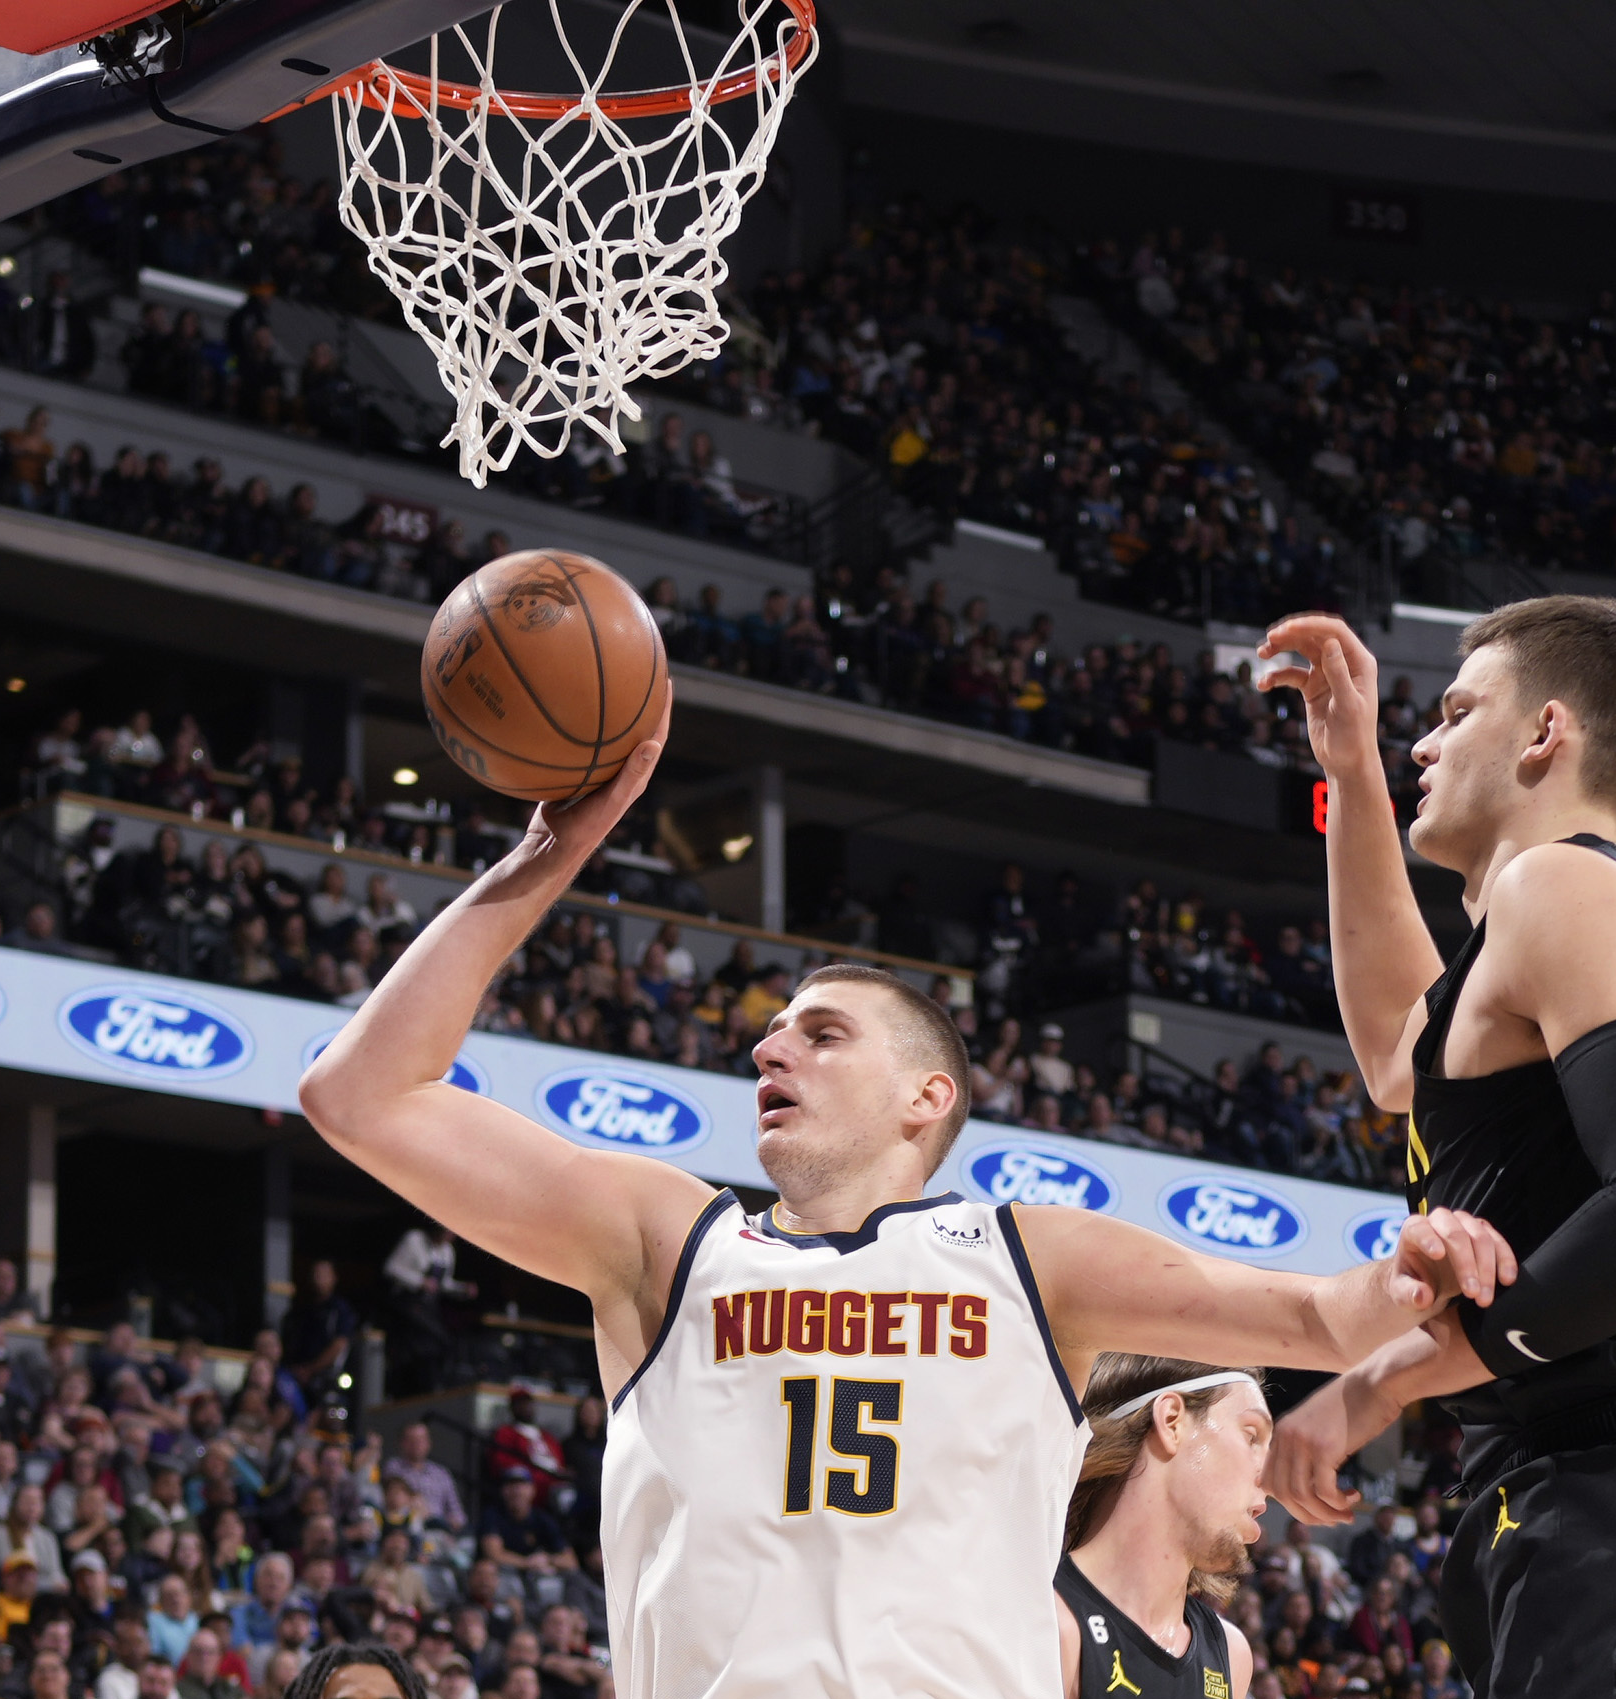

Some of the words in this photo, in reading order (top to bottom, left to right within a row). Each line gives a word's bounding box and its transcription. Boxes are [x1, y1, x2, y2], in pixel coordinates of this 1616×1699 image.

[1344, 199, 1409, 232] 350
[96, 995, 219, 1069] Ford
[570, 1079, 682, 1147] Ford
[991, 1152, 1091, 1208] Ford
[1184, 1187, 1281, 1248] Ford
[712, 1287, 989, 1364] NUGGETS
[780, 1375, 904, 1517] 15
[1087, 1615, 1109, 1644] 6
